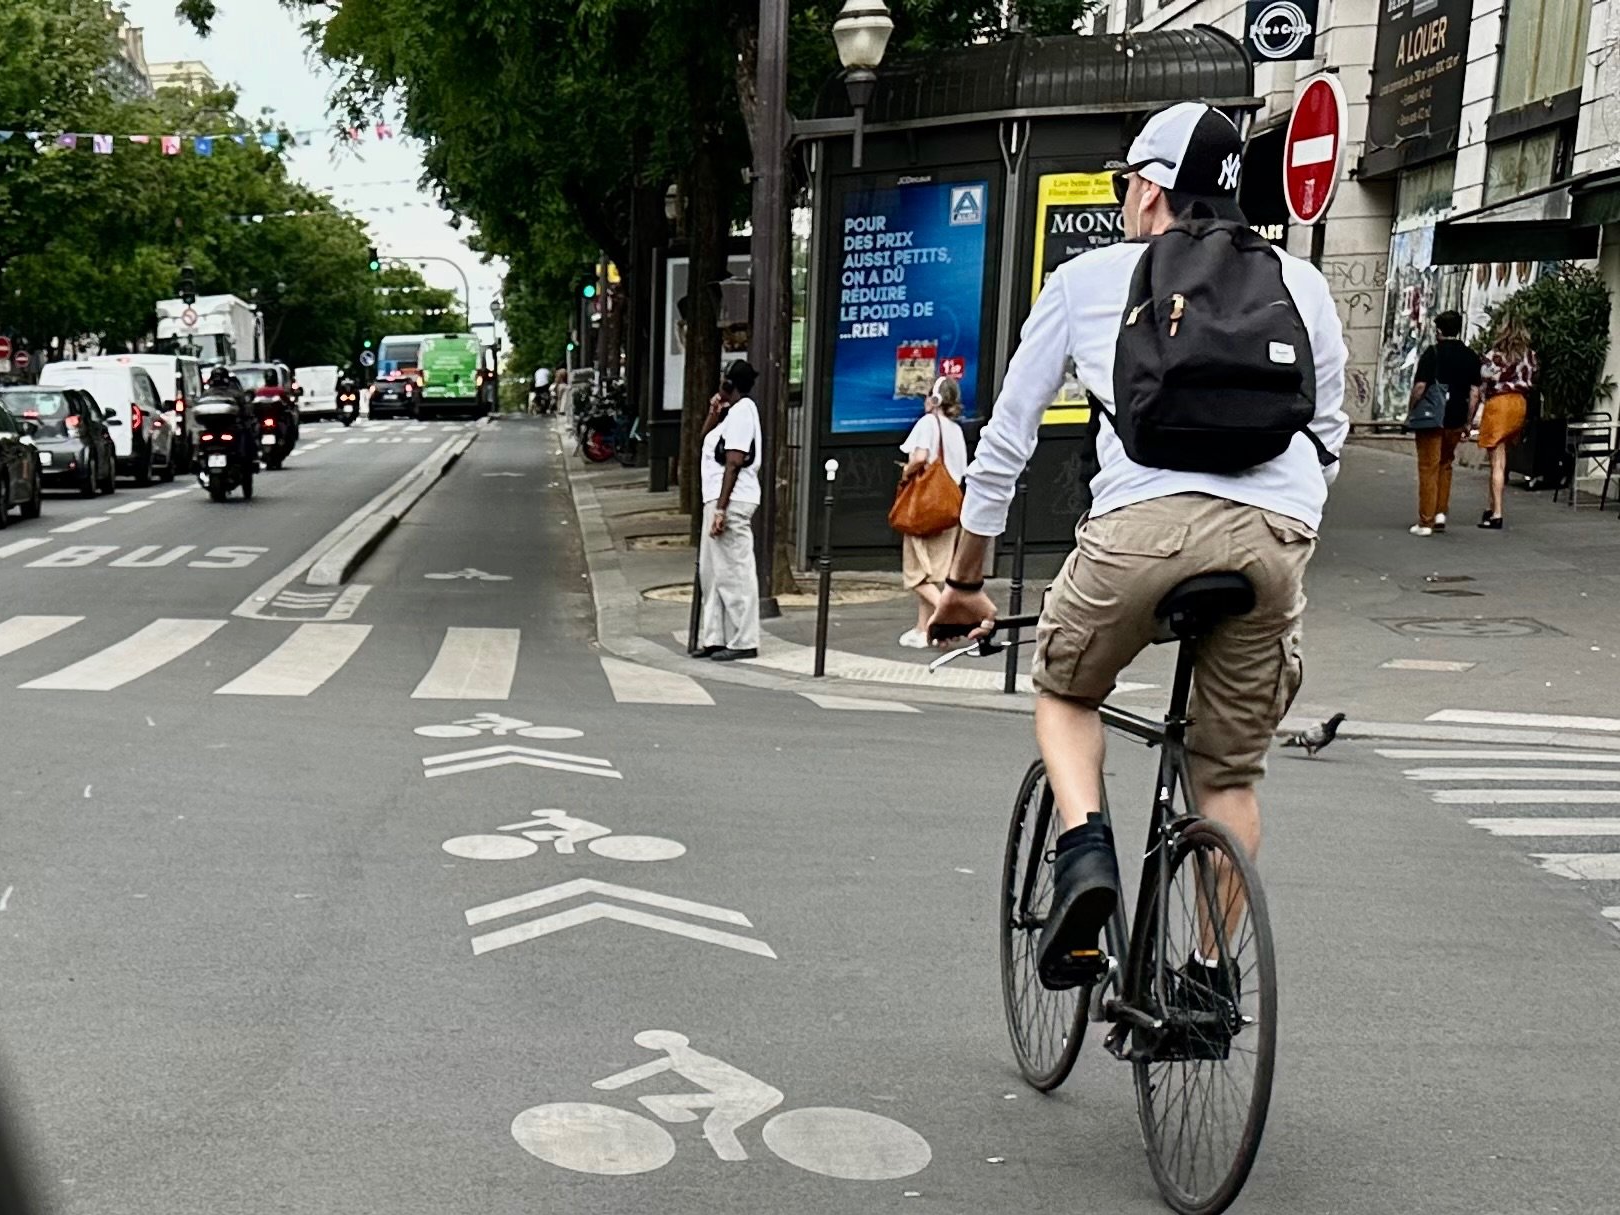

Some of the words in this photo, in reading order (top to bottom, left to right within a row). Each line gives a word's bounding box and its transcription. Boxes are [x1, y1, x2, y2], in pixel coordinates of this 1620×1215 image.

[1396, 34, 1405, 68] A
[1407, 16, 1447, 63] LOUER
[844, 216, 886, 233] POUR
[844, 234, 873, 251] DES
[876, 231, 914, 249] PRIX
[843, 250, 890, 269] AUSSI
[893, 247, 951, 265] PETITS,
[842, 270, 865, 286] ON
[867, 270, 880, 285] A
[882, 264, 905, 283] DÛ
[841, 284, 907, 304] RÉDUIRE
[840, 307, 858, 322] LE
[860, 303, 910, 321] POIDS
[913, 301, 934, 317] DE
[23, 545, 270, 568] BUS
